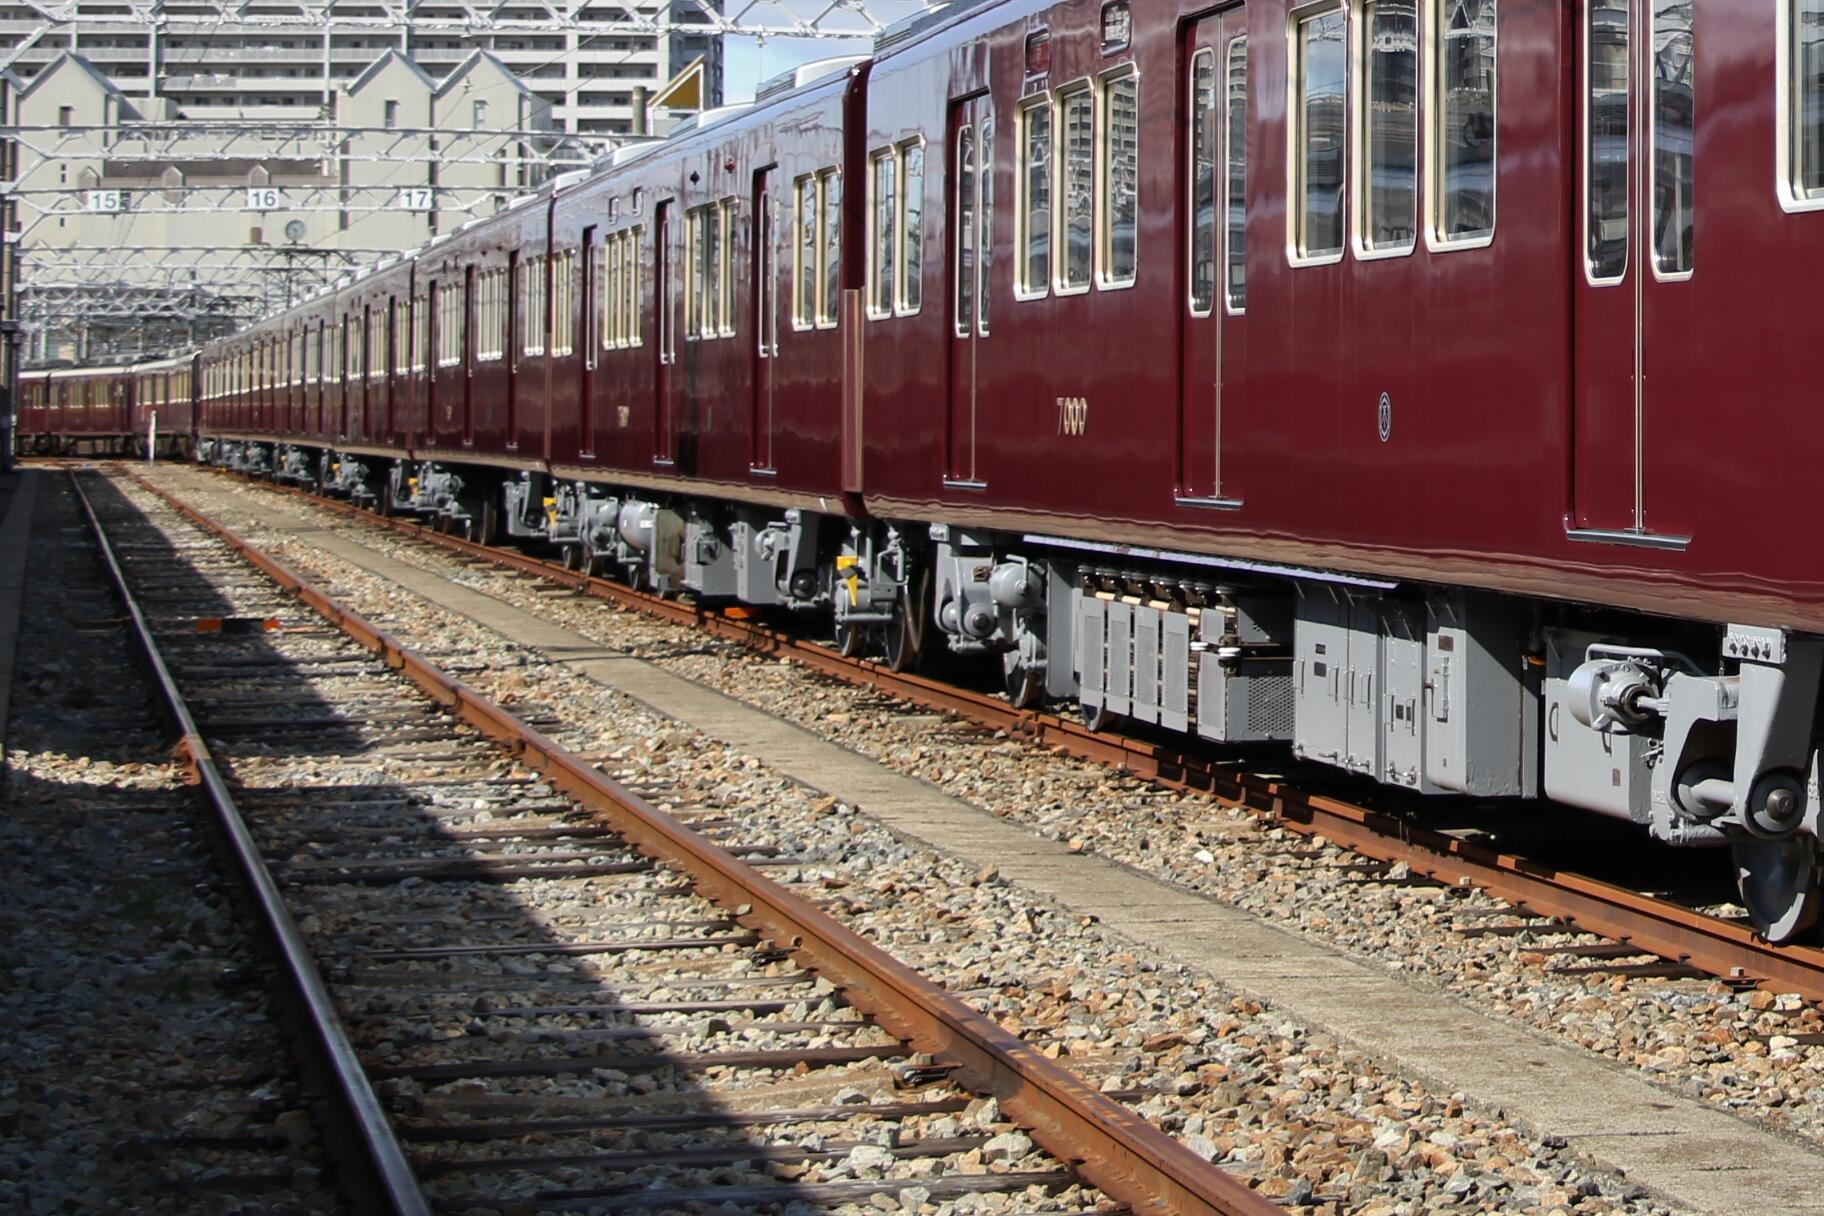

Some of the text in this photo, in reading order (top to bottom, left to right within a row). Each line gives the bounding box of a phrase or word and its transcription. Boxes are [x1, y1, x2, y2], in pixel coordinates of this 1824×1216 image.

[92, 192, 117, 210] 15
[252, 191, 277, 208] 16
[405, 191, 430, 207] 17
[1056, 397, 1088, 436] 7000
